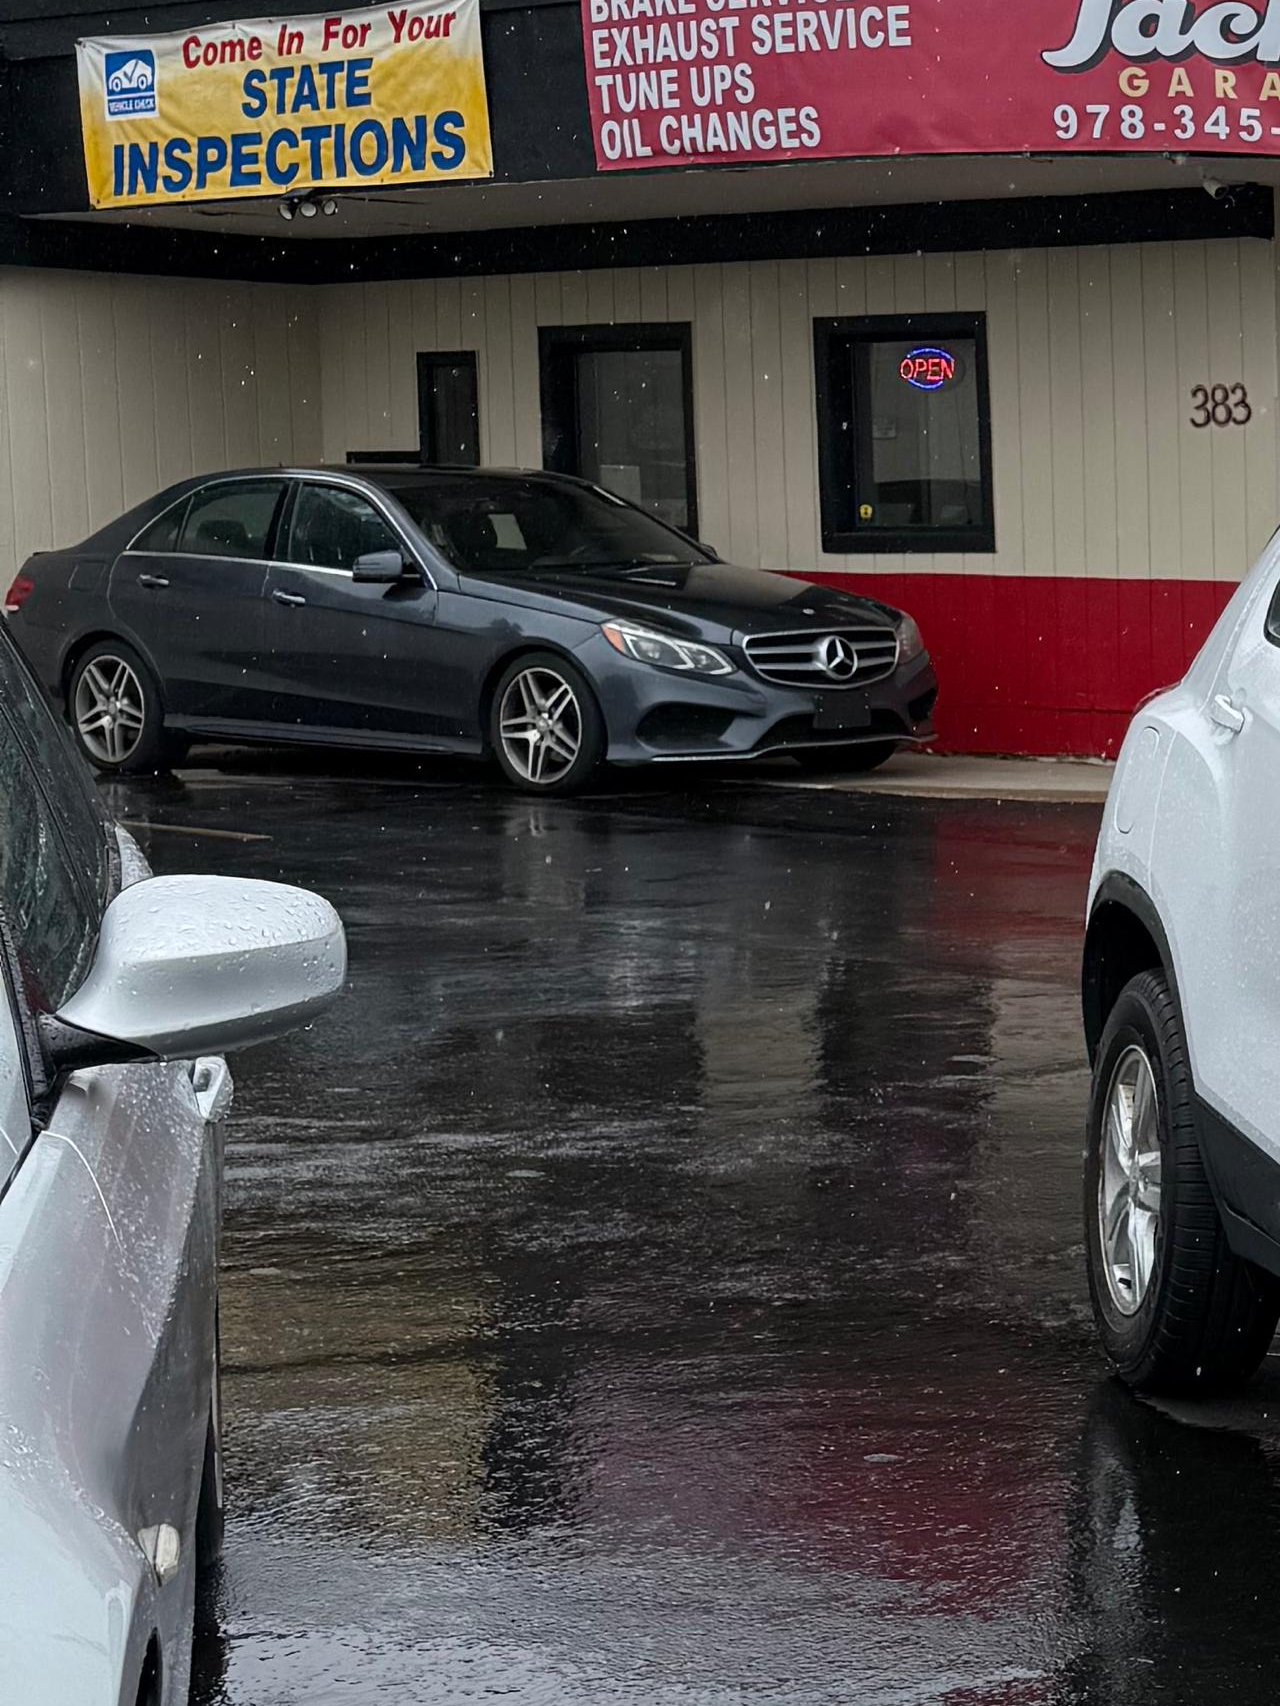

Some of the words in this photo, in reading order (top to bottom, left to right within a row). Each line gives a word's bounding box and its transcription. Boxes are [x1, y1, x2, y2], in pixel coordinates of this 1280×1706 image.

[182, 35, 263, 69] Come
[276, 24, 304, 57] In
[321, 17, 372, 53] For
[387, 9, 457, 45] Your
[592, 16, 739, 69] EXHAUST
[751, 5, 912, 55] SERVICE
[241, 58, 374, 119] STATE
[595, 68, 680, 114] TUNE
[690, 62, 755, 107] UPS
[112, 111, 467, 197] INSPECTIONS
[600, 118, 653, 160] OIL
[660, 106, 821, 155] CHANGES
[900, 358, 955, 380] OPEN
[1190, 382, 1251, 428] 383
